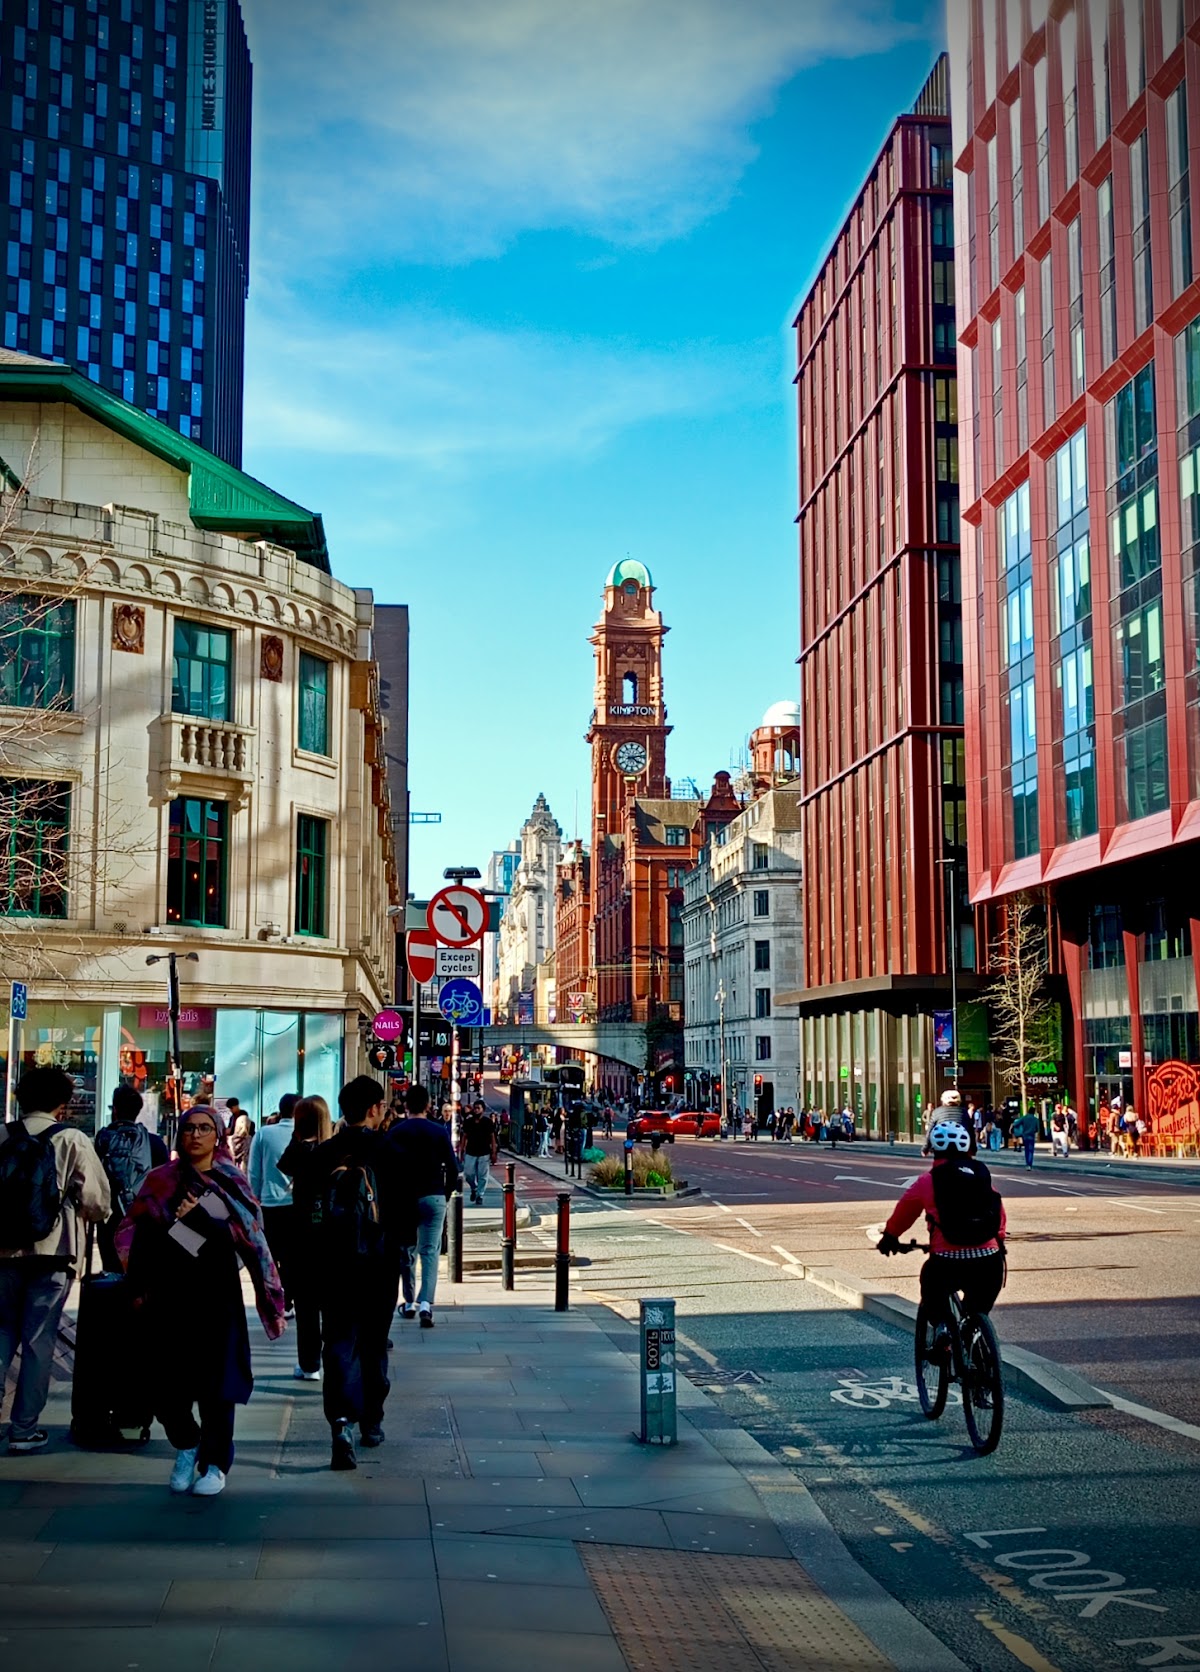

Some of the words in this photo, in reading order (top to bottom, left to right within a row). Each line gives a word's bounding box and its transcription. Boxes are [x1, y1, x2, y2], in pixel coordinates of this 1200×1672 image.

[203, 0, 217, 80] STUDENTS
[202, 84, 216, 130] UNITE
[609, 706, 656, 716] KIMPTON
[441, 952, 475, 963] Except
[441, 963, 473, 974] cycles
[180, 1009, 198, 1022] ails
[375, 1021, 400, 1030] NAILS
[1026, 1075, 1058, 1085] xpress
[962, 1527, 1168, 1618] LOOK
